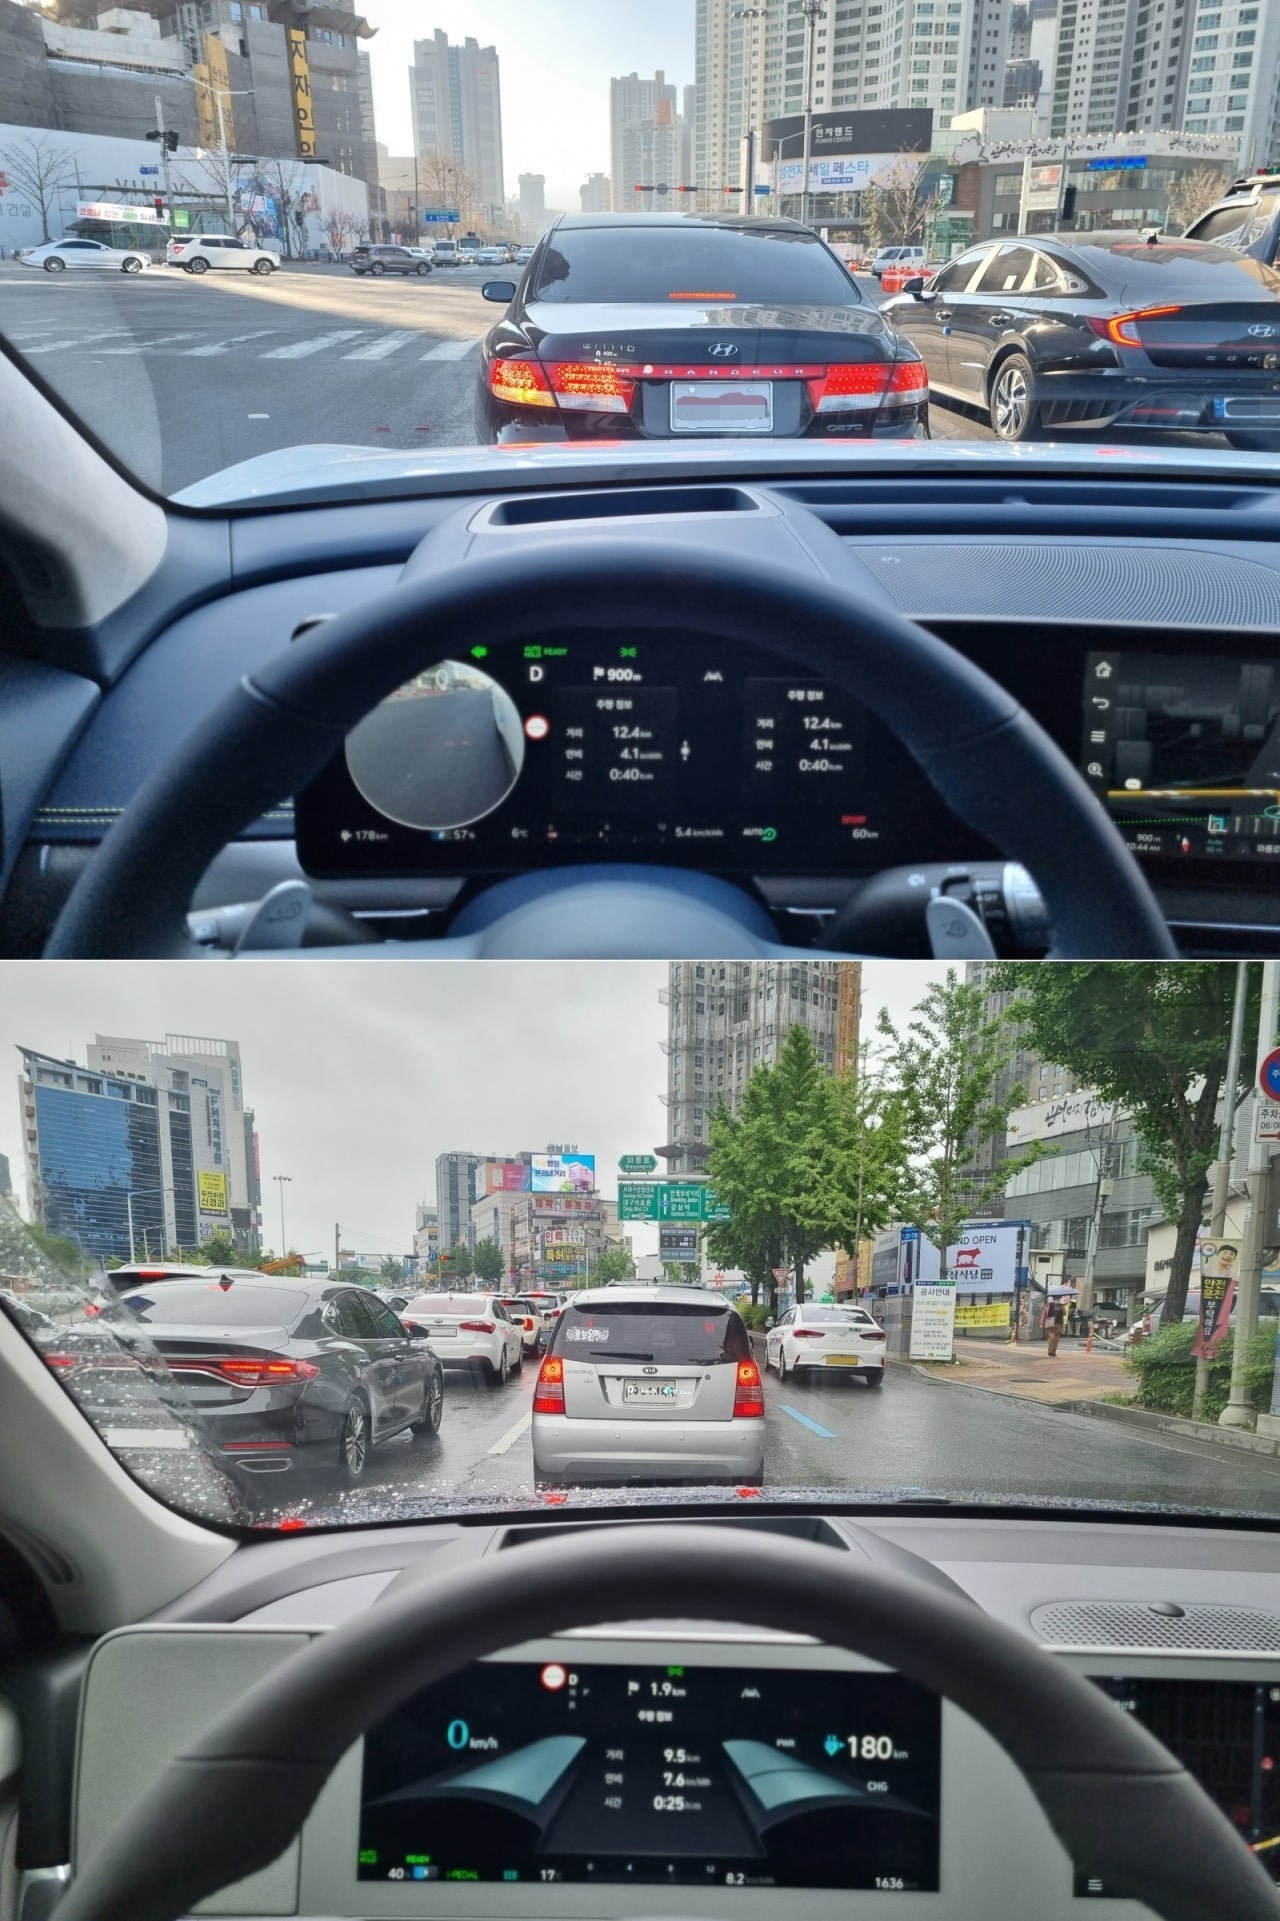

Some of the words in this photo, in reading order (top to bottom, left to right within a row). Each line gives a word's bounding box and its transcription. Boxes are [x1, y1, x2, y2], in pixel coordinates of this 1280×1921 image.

[815, 126, 853, 138] 전자랜드
[808, 162, 830, 177] 세일
[832, 160, 870, 176] 페스타
[530, 667, 542, 682] D
[1261, 1108, 1280, 1118] 주차
[972, 1234, 997, 1245] OPEN
[1204, 1279, 1226, 1289] 안전
[920, 1288, 950, 1297] 공사안내
[1204, 1301, 1217, 1336] 부탁해요
[447, 1719, 469, 1749] 0
[469, 1737, 498, 1749] km/h
[867, 1781, 888, 1792] CHG
